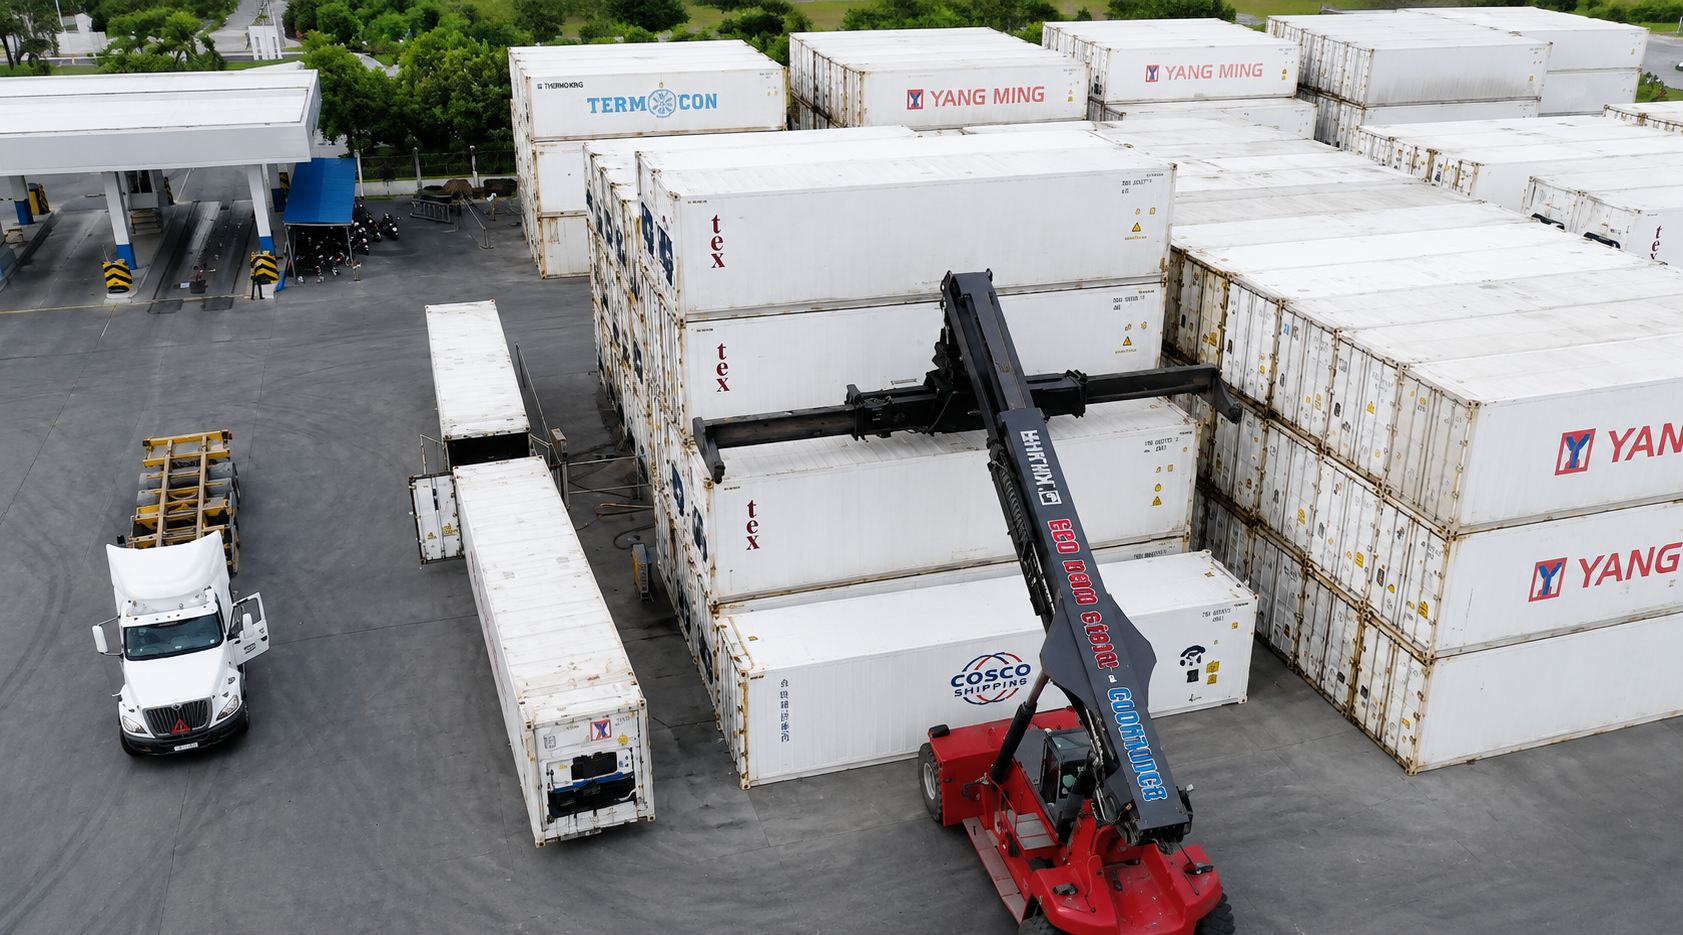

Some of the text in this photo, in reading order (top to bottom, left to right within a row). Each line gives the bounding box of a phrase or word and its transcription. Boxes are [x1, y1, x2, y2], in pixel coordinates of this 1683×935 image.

[1165, 64, 1213, 81] YANG
[1219, 63, 1263, 78] MING
[930, 89, 986, 107] YANG
[993, 86, 1045, 104] MING
[710, 214, 726, 268] tex
[716, 343, 730, 392] tex
[746, 500, 760, 550] tex
[1578, 542, 1683, 588] YANG
[950, 663, 1031, 688] COSCO
